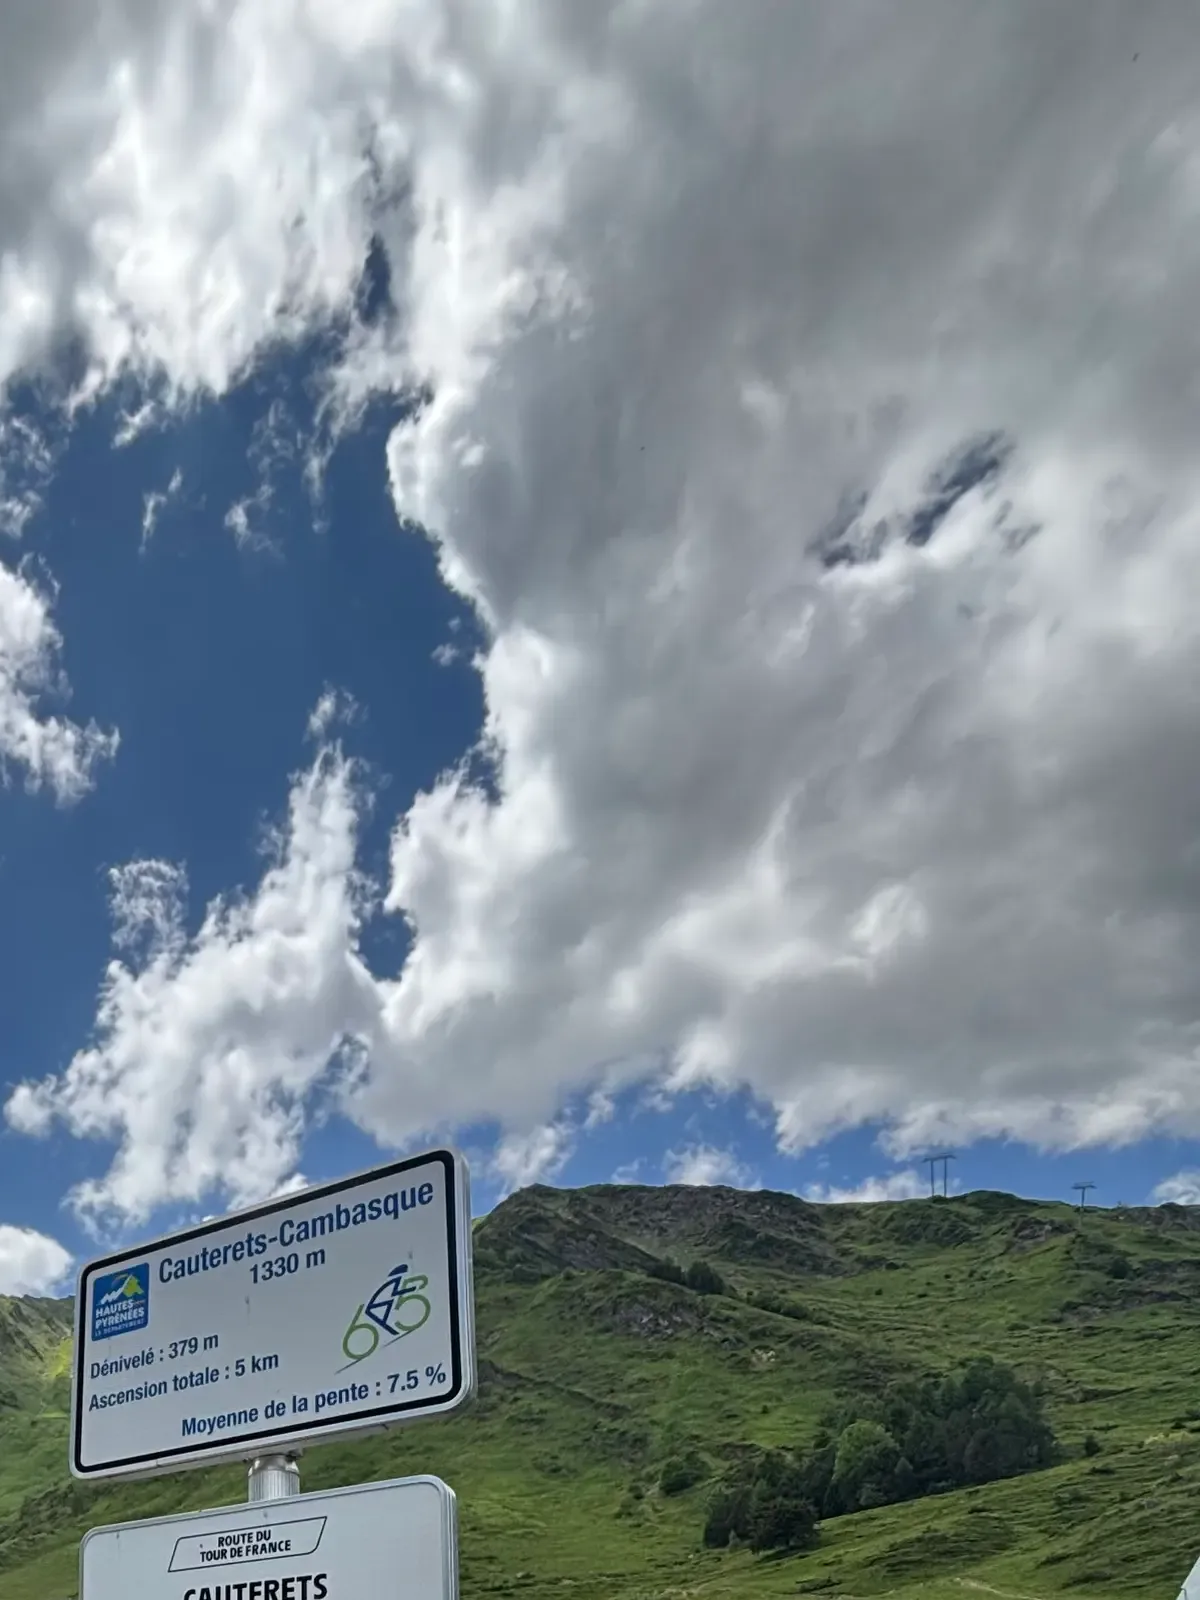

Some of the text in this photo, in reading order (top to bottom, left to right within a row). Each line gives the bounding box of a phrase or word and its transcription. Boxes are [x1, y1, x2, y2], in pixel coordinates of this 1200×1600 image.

[159, 1182, 434, 1283] Cauterets-Cambasque
[250, 1249, 326, 1284] 1330 m
[95, 1299, 134, 1318] HAUTES
[95, 1307, 145, 1330] PYRÉNÉES
[90, 1347, 155, 1380] Dénivelé
[168, 1336, 199, 1359] 379
[203, 1334, 219, 1350] m
[88, 1381, 168, 1412] Ascension
[172, 1367, 219, 1391] totale
[235, 1359, 246, 1377] 5
[251, 1354, 279, 1374] km
[182, 1408, 259, 1437] Moyenne
[264, 1400, 286, 1420] de
[292, 1395, 308, 1413] la
[315, 1383, 369, 1413] pente
[387, 1369, 419, 1394] 7.5
[425, 1363, 447, 1387] %
[200, 1540, 291, 1563] TOUR DE FRANCE
[218, 1530, 272, 1548] ROUTE DU
